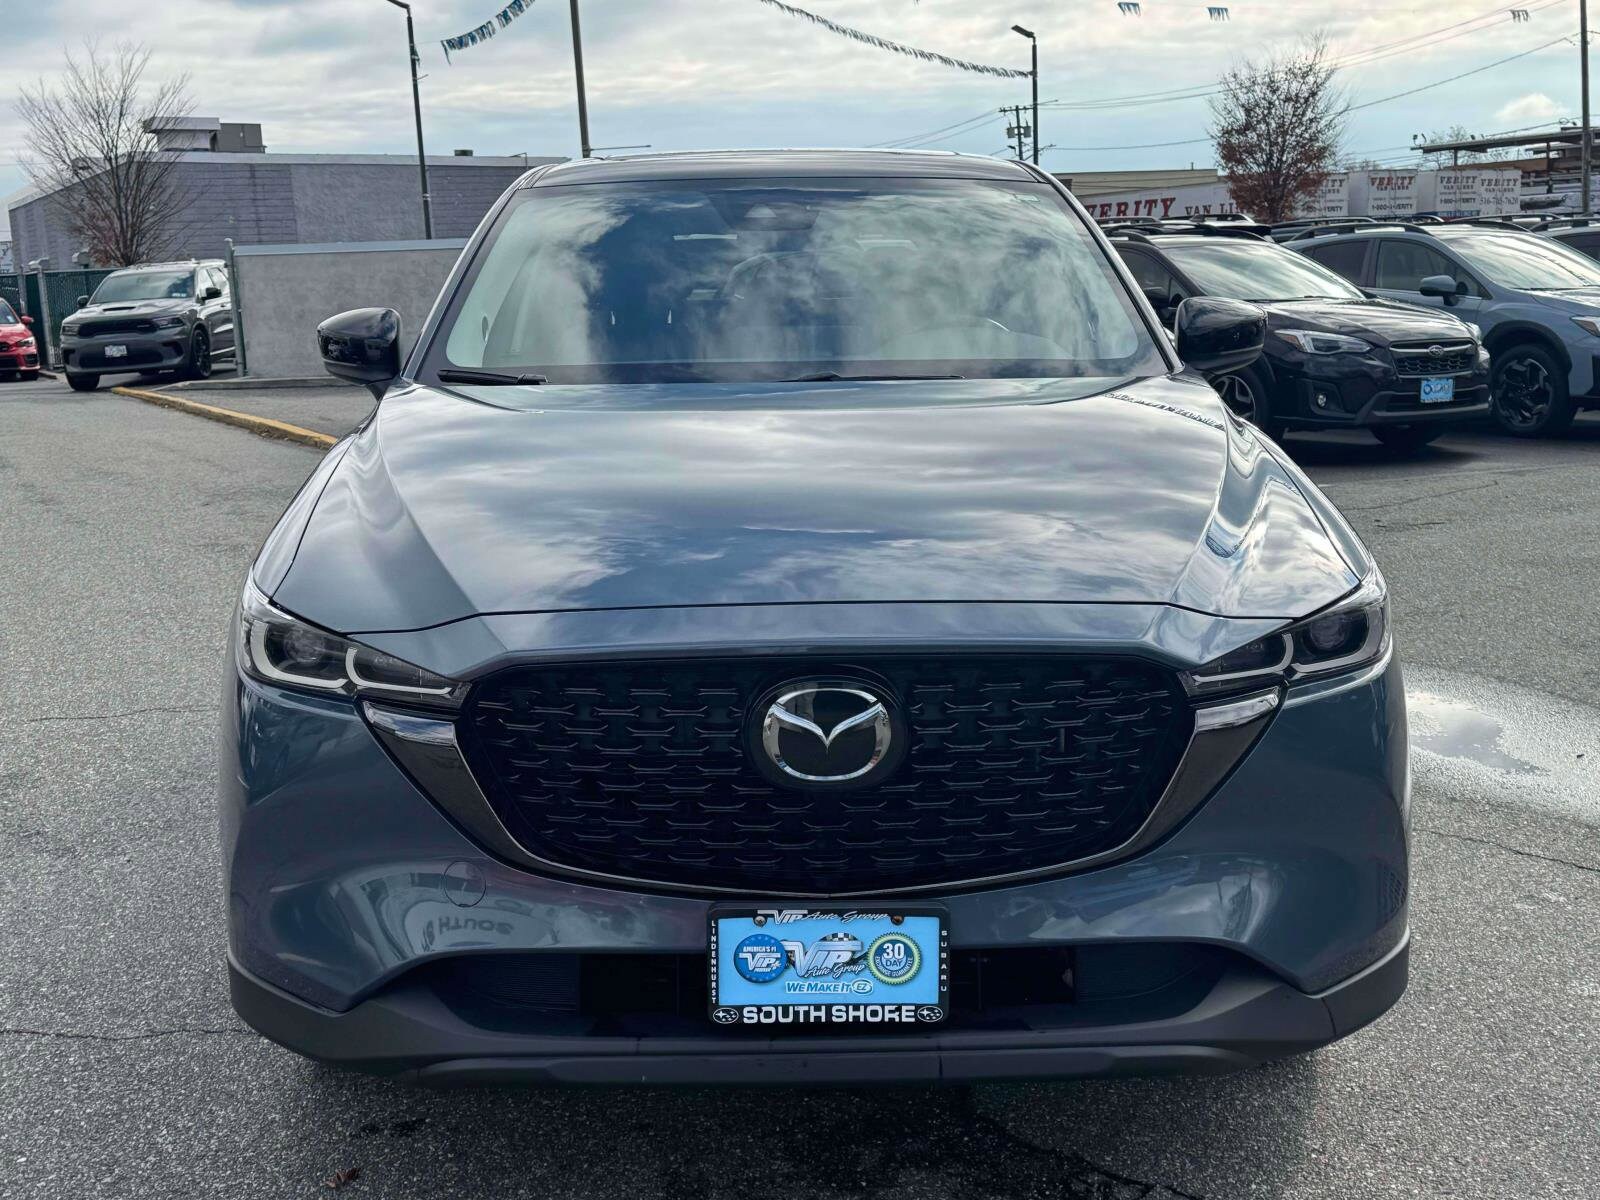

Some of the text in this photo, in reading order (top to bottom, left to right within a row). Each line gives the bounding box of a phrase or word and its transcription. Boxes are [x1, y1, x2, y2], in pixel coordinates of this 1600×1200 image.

[1185, 204, 1212, 216] VAN
[757, 909, 889, 925] VIP Auto Group
[780, 940, 863, 977] VIP
[882, 942, 905, 960] 30
[739, 953, 781, 970] VIP
[885, 959, 904, 968] DAY
[940, 930, 948, 992] SUBARU
[803, 963, 866, 979] Auto Group
[743, 1005, 917, 1024] SOUTH SHORE
